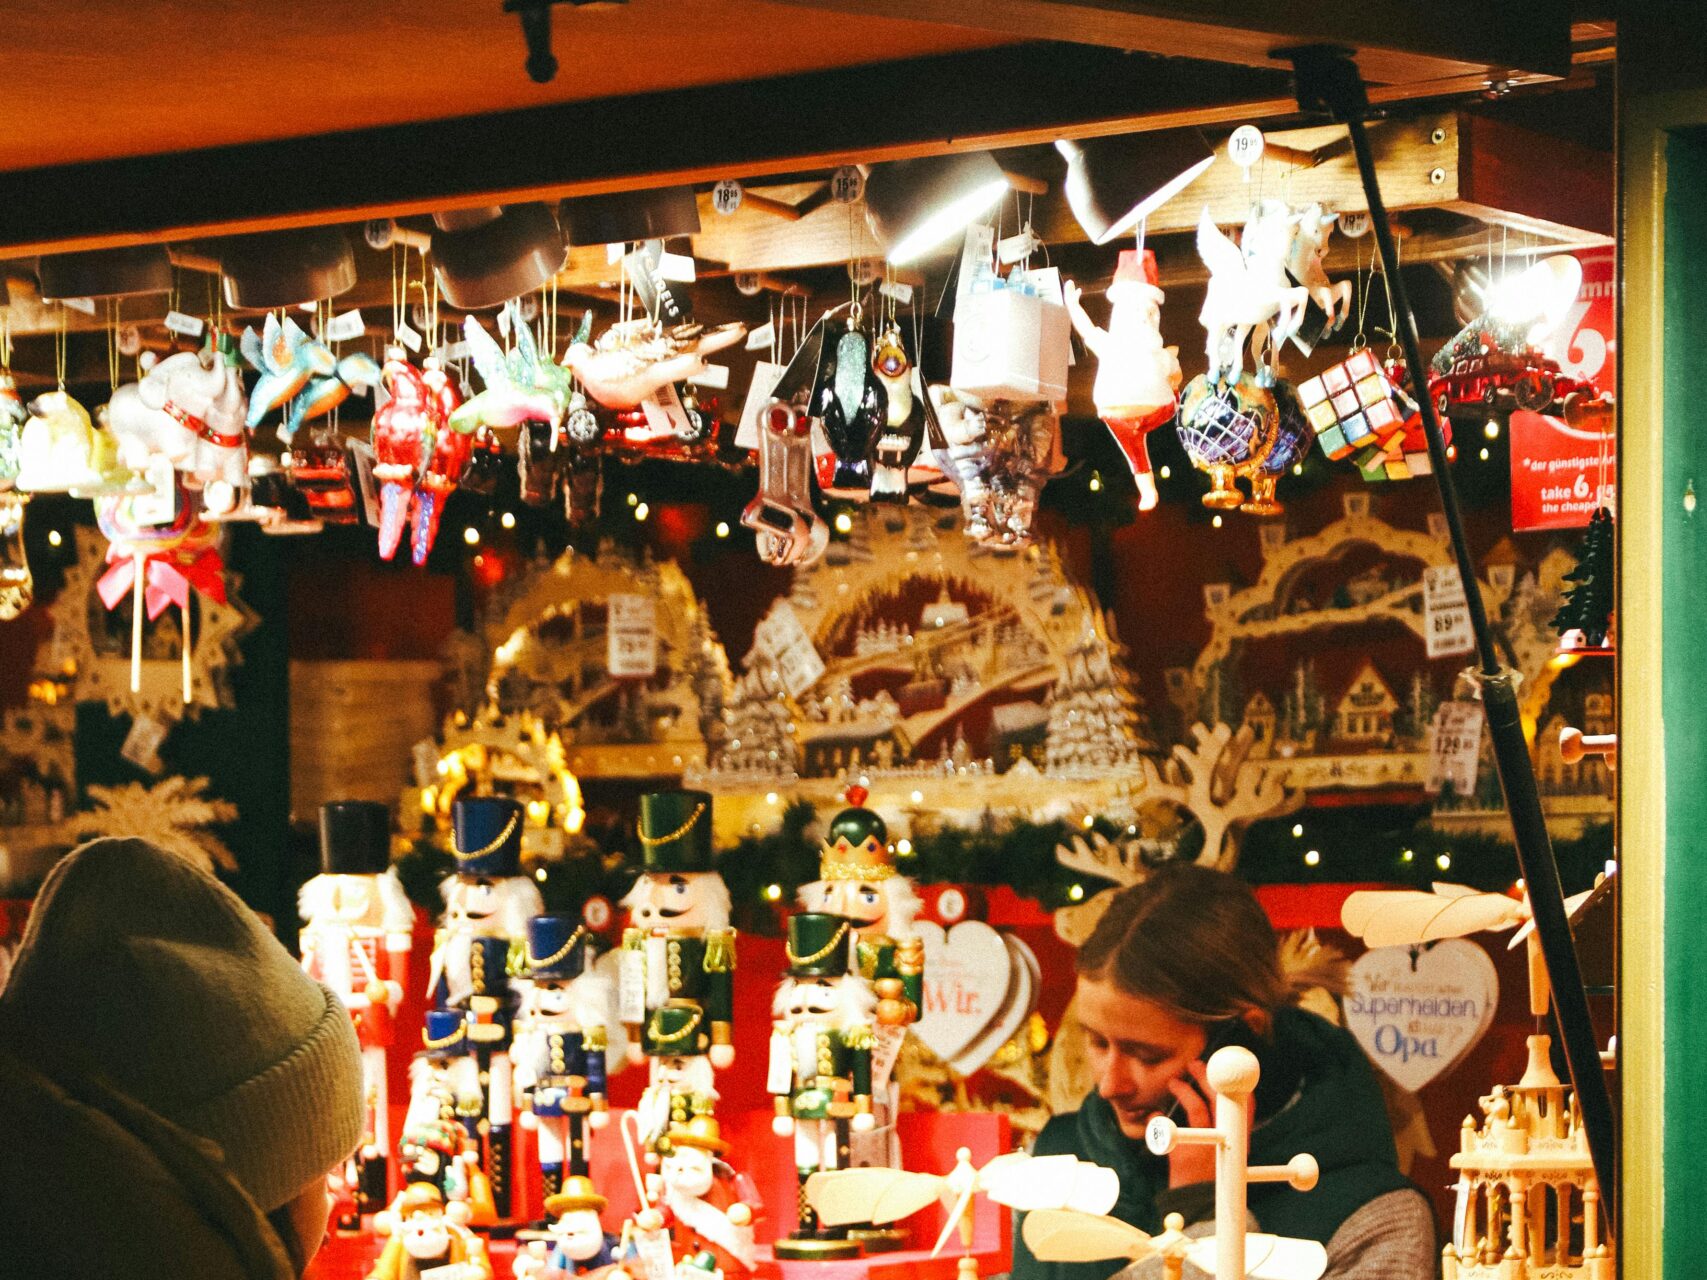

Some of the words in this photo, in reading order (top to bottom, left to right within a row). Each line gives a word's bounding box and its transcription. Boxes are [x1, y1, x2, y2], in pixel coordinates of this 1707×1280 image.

[1548, 456, 1599, 473] günstigste
[1541, 485, 1571, 500] take
[1541, 503, 1560, 513] the
[1374, 1024, 1438, 1064] Opa
